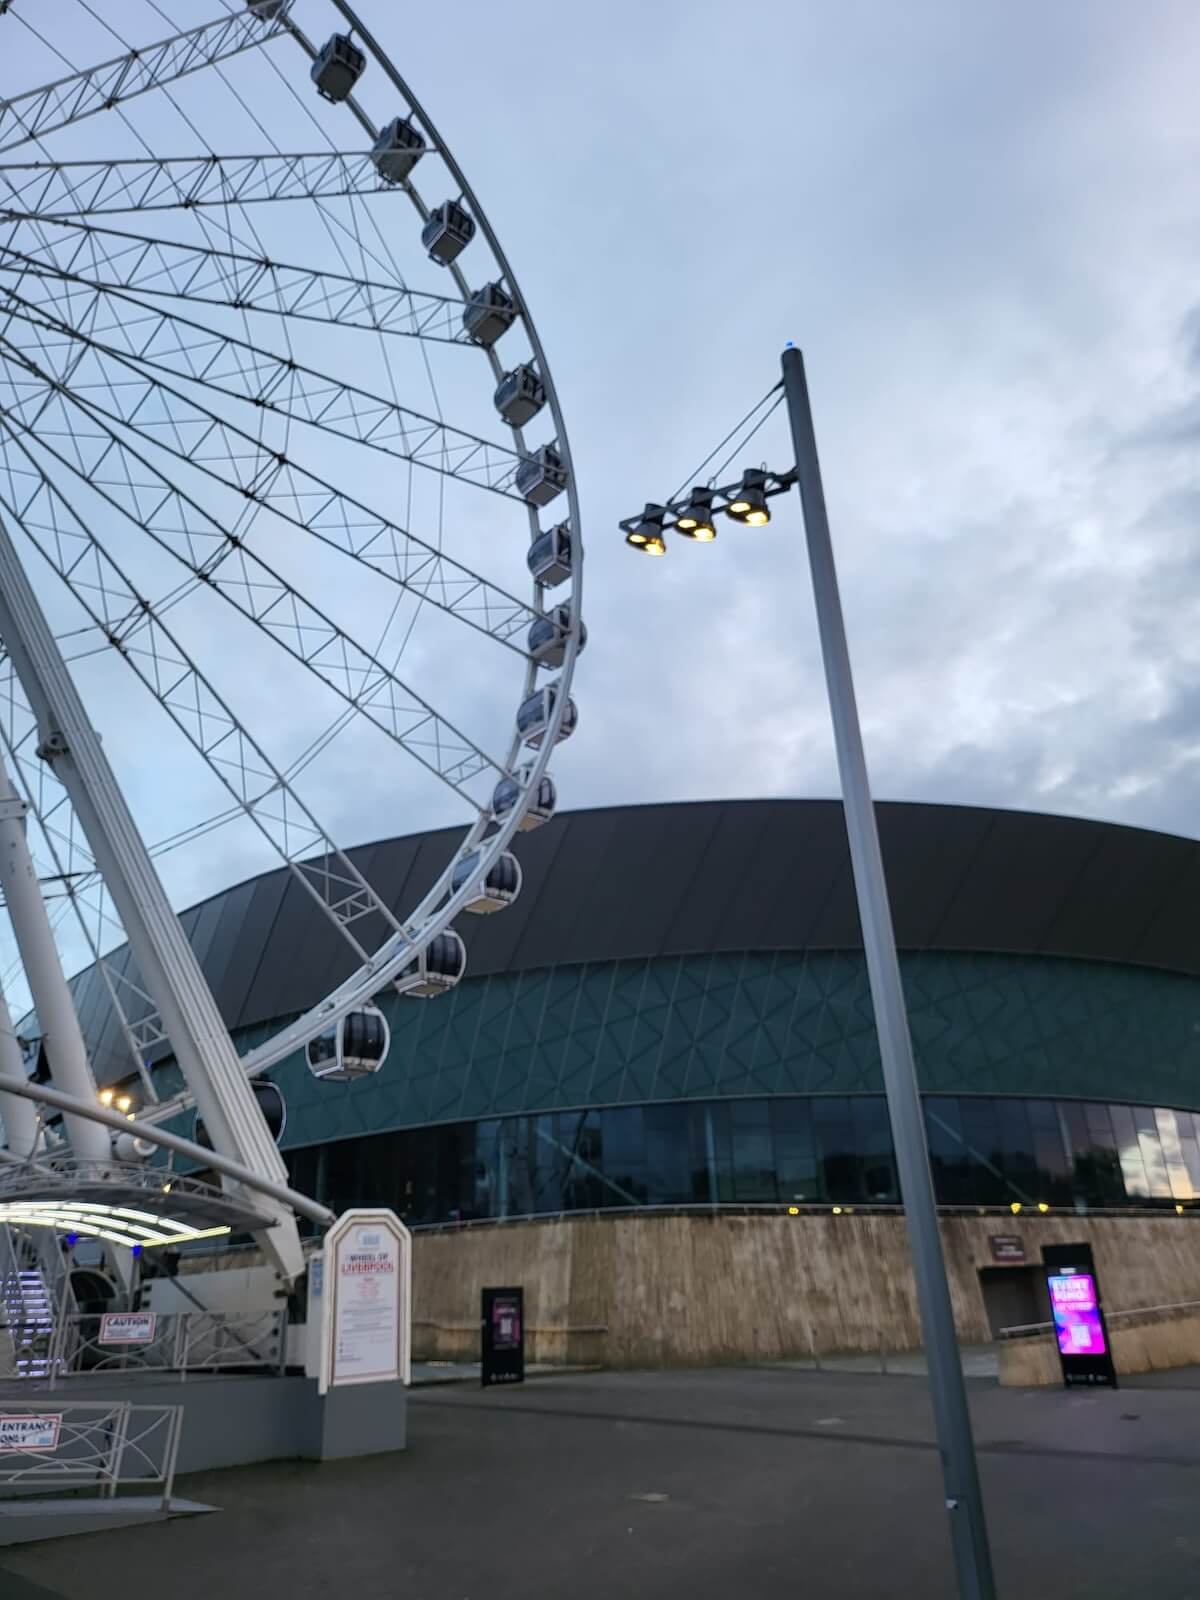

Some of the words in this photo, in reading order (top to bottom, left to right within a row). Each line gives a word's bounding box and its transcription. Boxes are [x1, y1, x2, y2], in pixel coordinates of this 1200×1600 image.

[107, 1317, 149, 1327] CAUTION
[2, 1421, 53, 1431] ENTRANCE
[0, 1434, 26, 1443] ONLY
